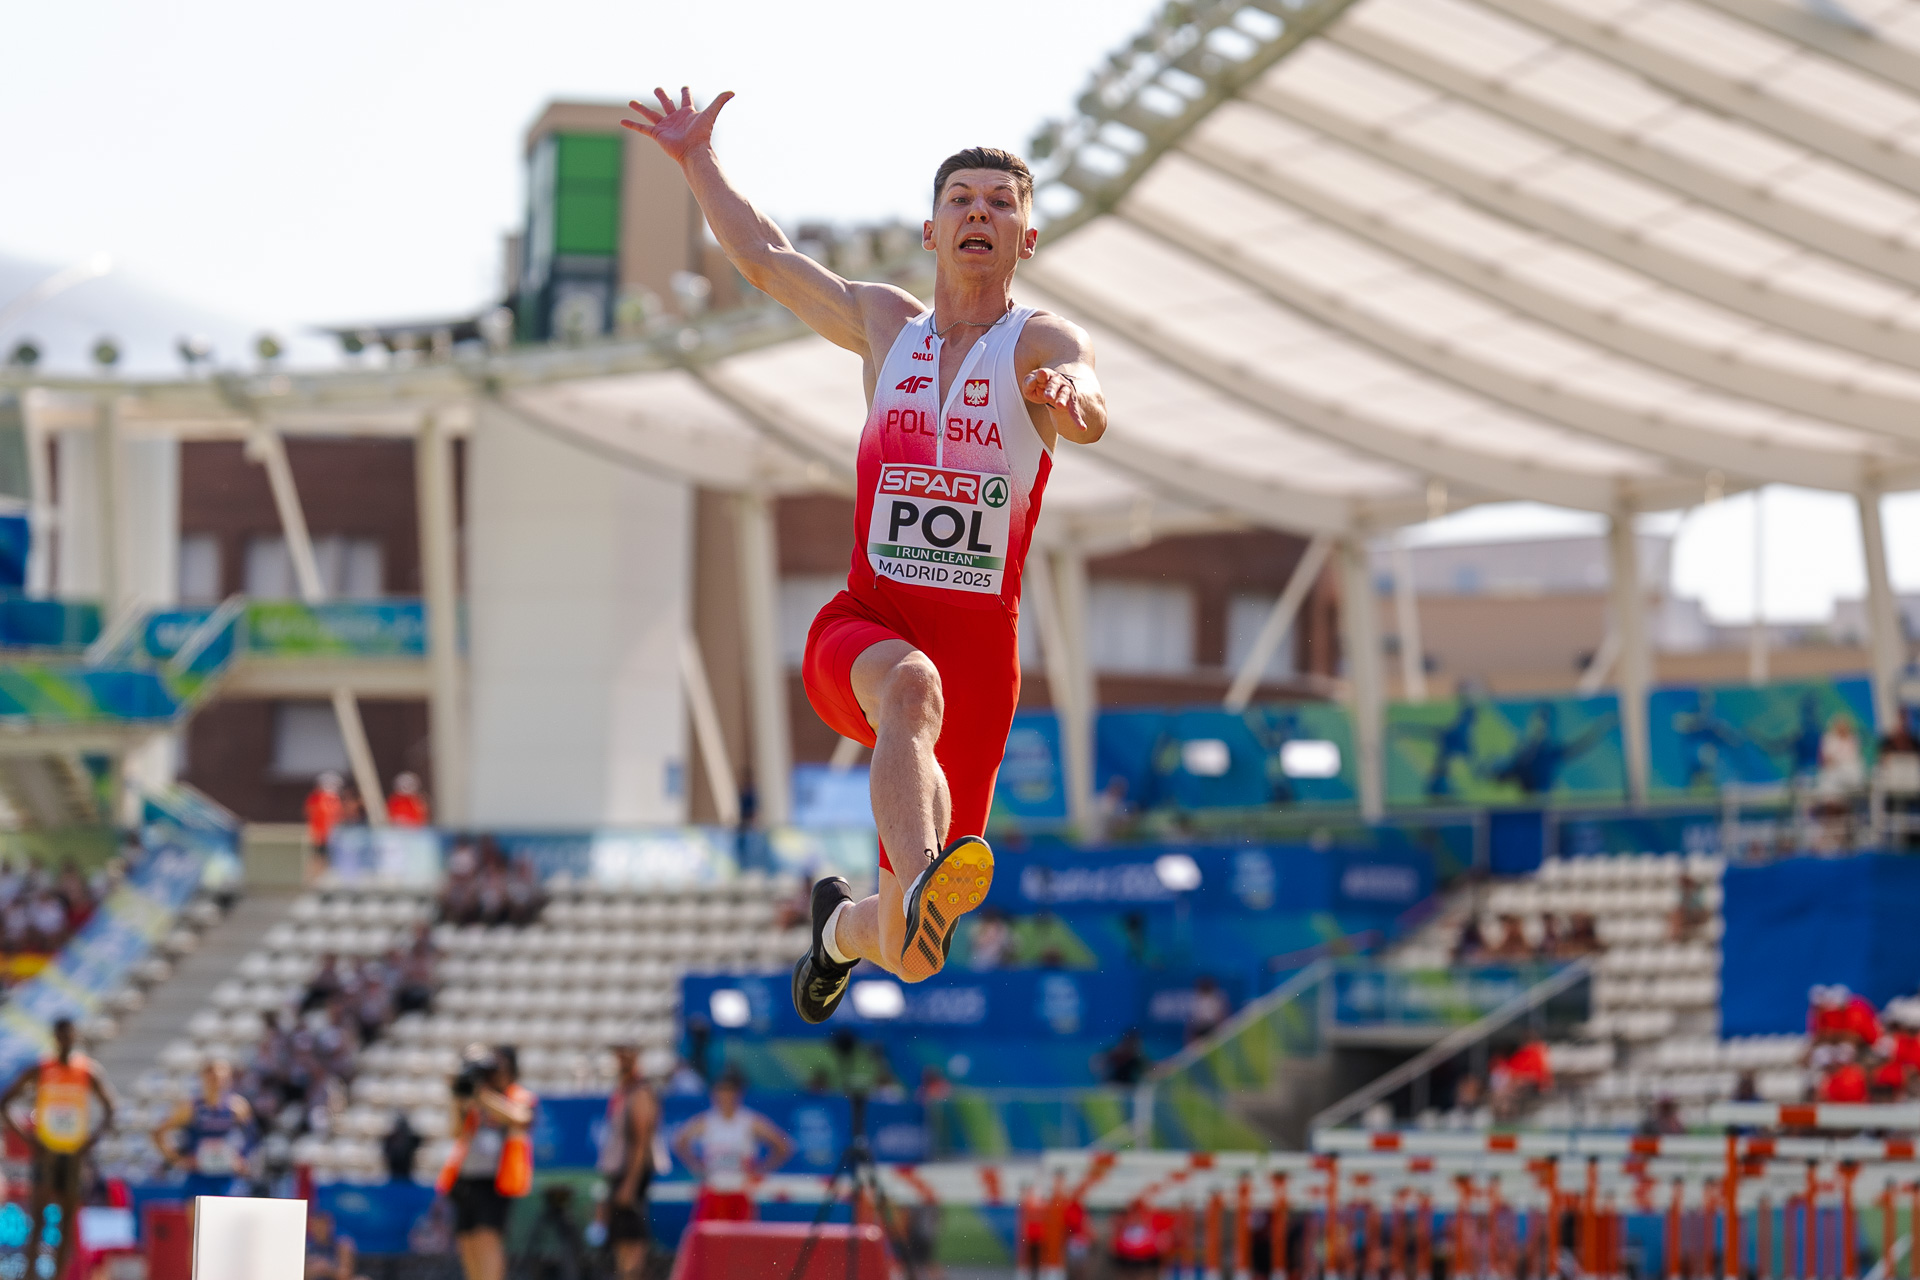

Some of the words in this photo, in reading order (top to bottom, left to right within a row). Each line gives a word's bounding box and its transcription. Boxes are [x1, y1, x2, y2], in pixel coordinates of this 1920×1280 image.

[895, 376, 933, 393] 4F
[883, 470, 977, 501] SPAR
[888, 500, 992, 553] POL
[896, 547, 900, 556] I
[902, 547, 930, 560] RUN
[879, 559, 949, 582] MADRID
[952, 570, 992, 588] 2025
